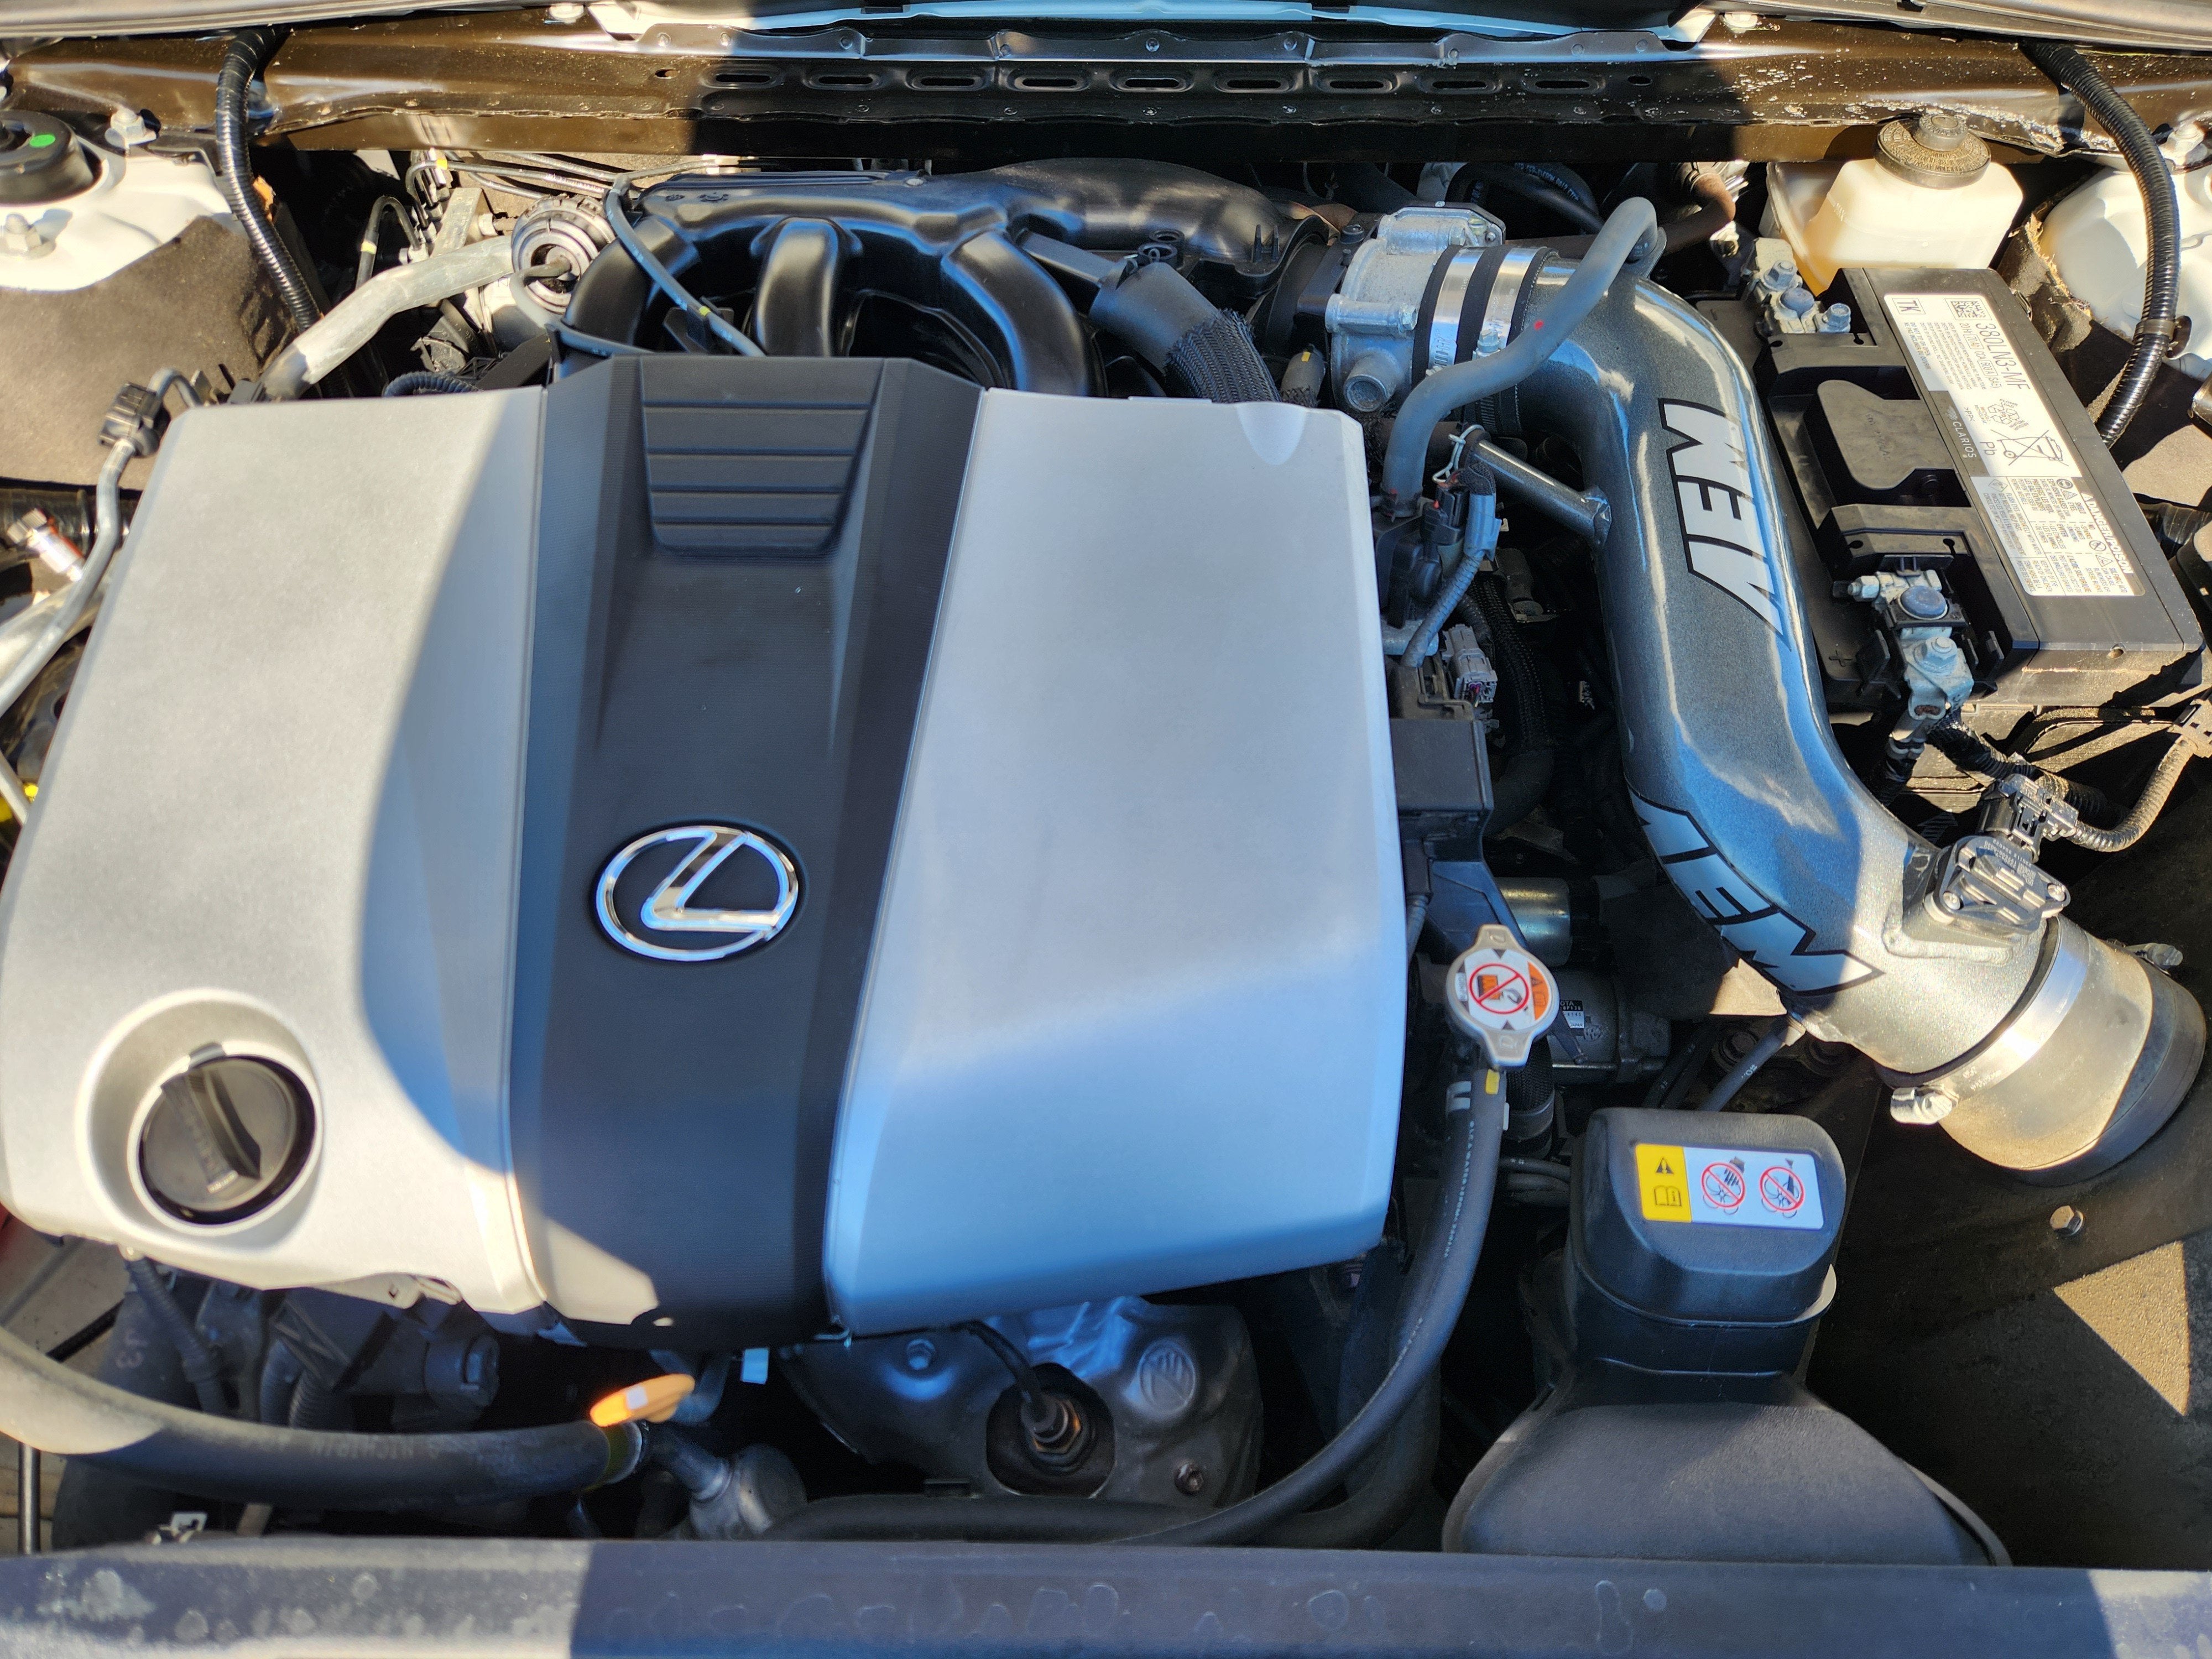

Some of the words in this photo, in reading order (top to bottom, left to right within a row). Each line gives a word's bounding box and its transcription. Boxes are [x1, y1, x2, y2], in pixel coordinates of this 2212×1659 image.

[1895, 300, 1921, 312] TK
[1973, 351, 1987, 359] CCA
[1974, 322, 2031, 389] 380LN3-MF
[1979, 362, 1994, 371] 603
[1984, 376, 2003, 388] (SAE)
[1950, 421, 1978, 458] CLARIOS
[1979, 441, 2000, 455] Pb
[1658, 398, 1791, 651] AEM
[2084, 500, 2135, 574] DANGER/POISON
[1624, 781, 1886, 997] AEM
